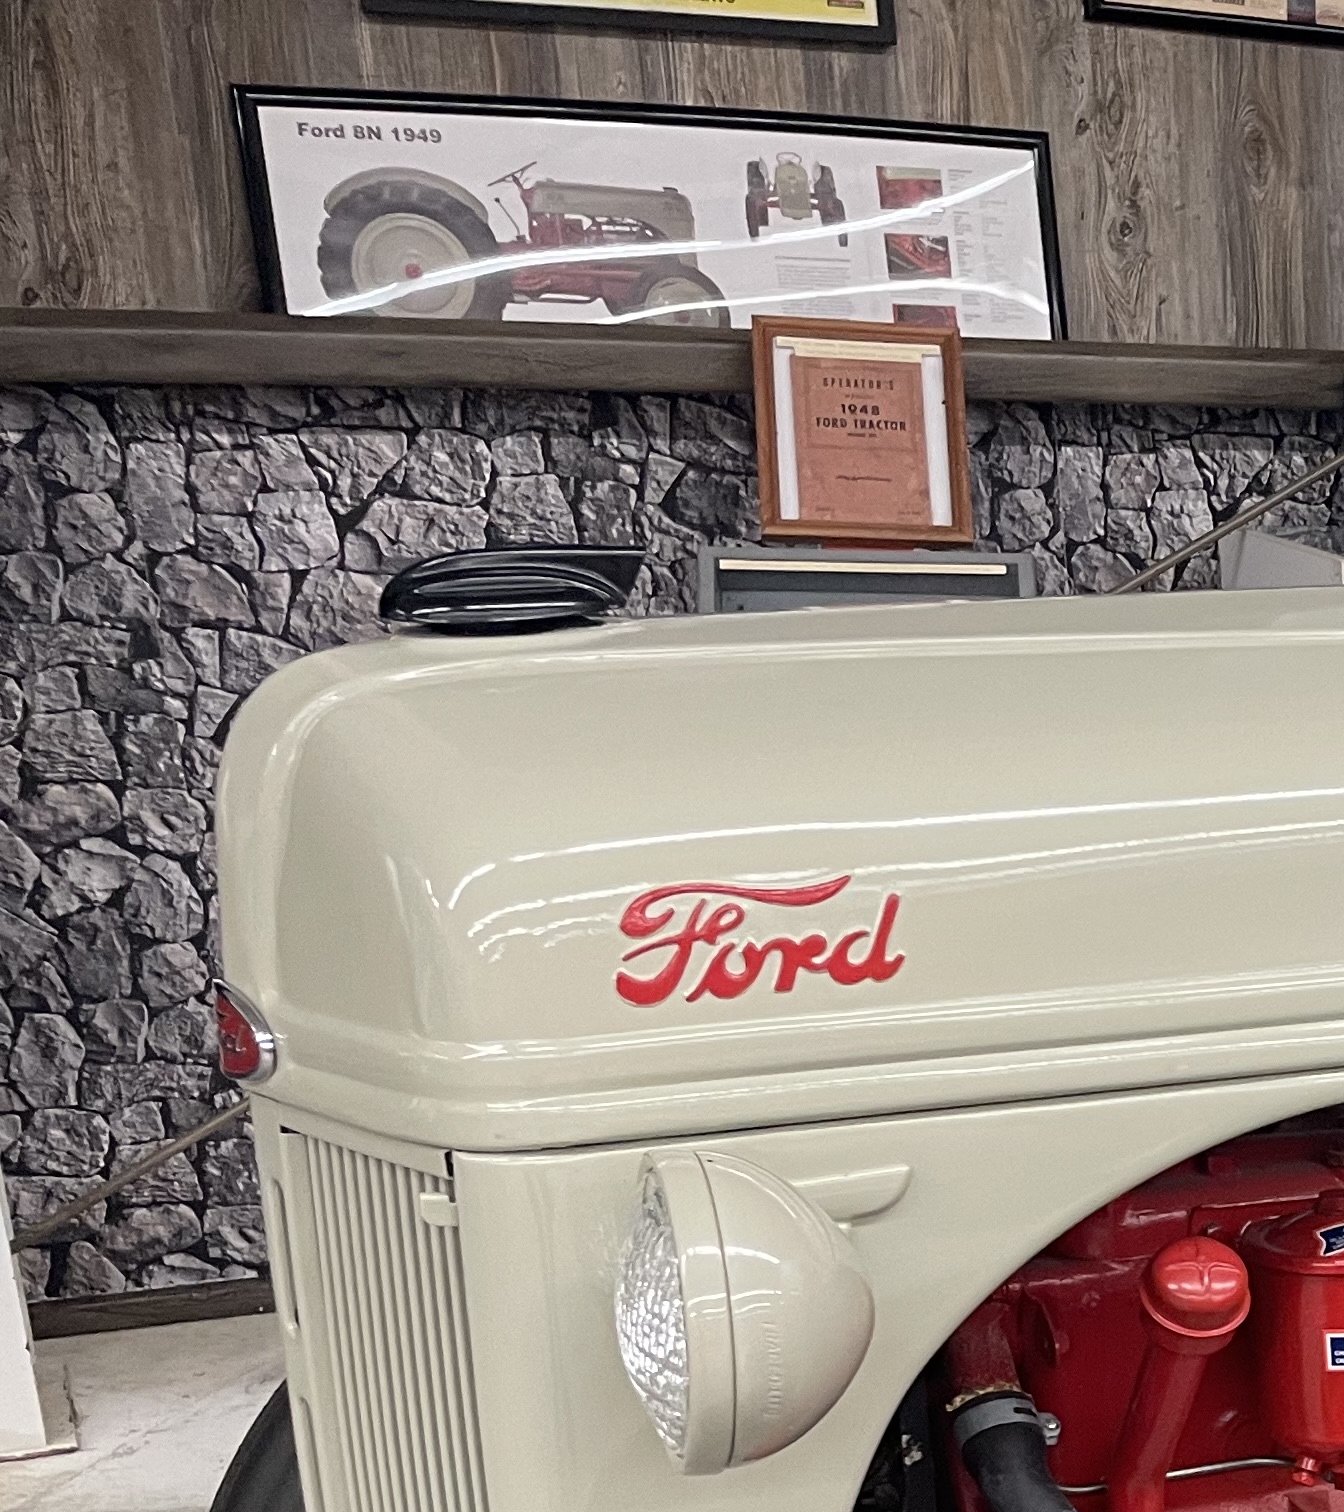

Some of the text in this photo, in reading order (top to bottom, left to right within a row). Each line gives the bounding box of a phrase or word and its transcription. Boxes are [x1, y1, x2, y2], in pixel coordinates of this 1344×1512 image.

[296, 121, 442, 143] Ford 8N 1949
[816, 417, 907, 431] FORD TRACTOR
[615, 874, 906, 1008] Ford
